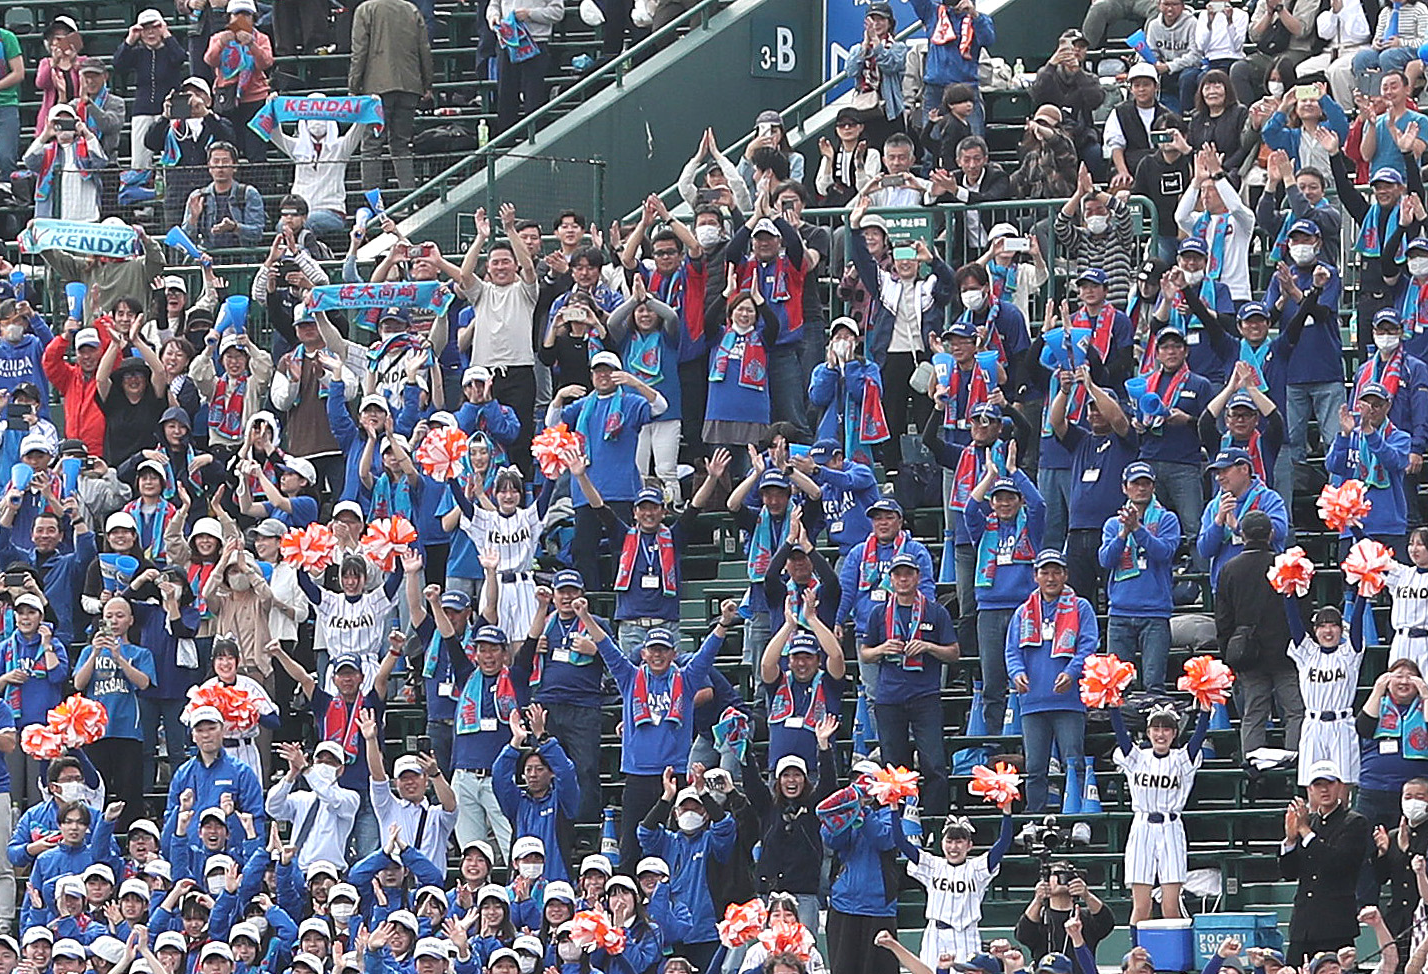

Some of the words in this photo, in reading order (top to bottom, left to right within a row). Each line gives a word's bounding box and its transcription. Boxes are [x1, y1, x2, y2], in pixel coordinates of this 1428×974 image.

[760, 27, 796, 73] 3-B
[284, 98, 362, 113] KENDAI
[339, 283, 418, 299] 健大高崎
